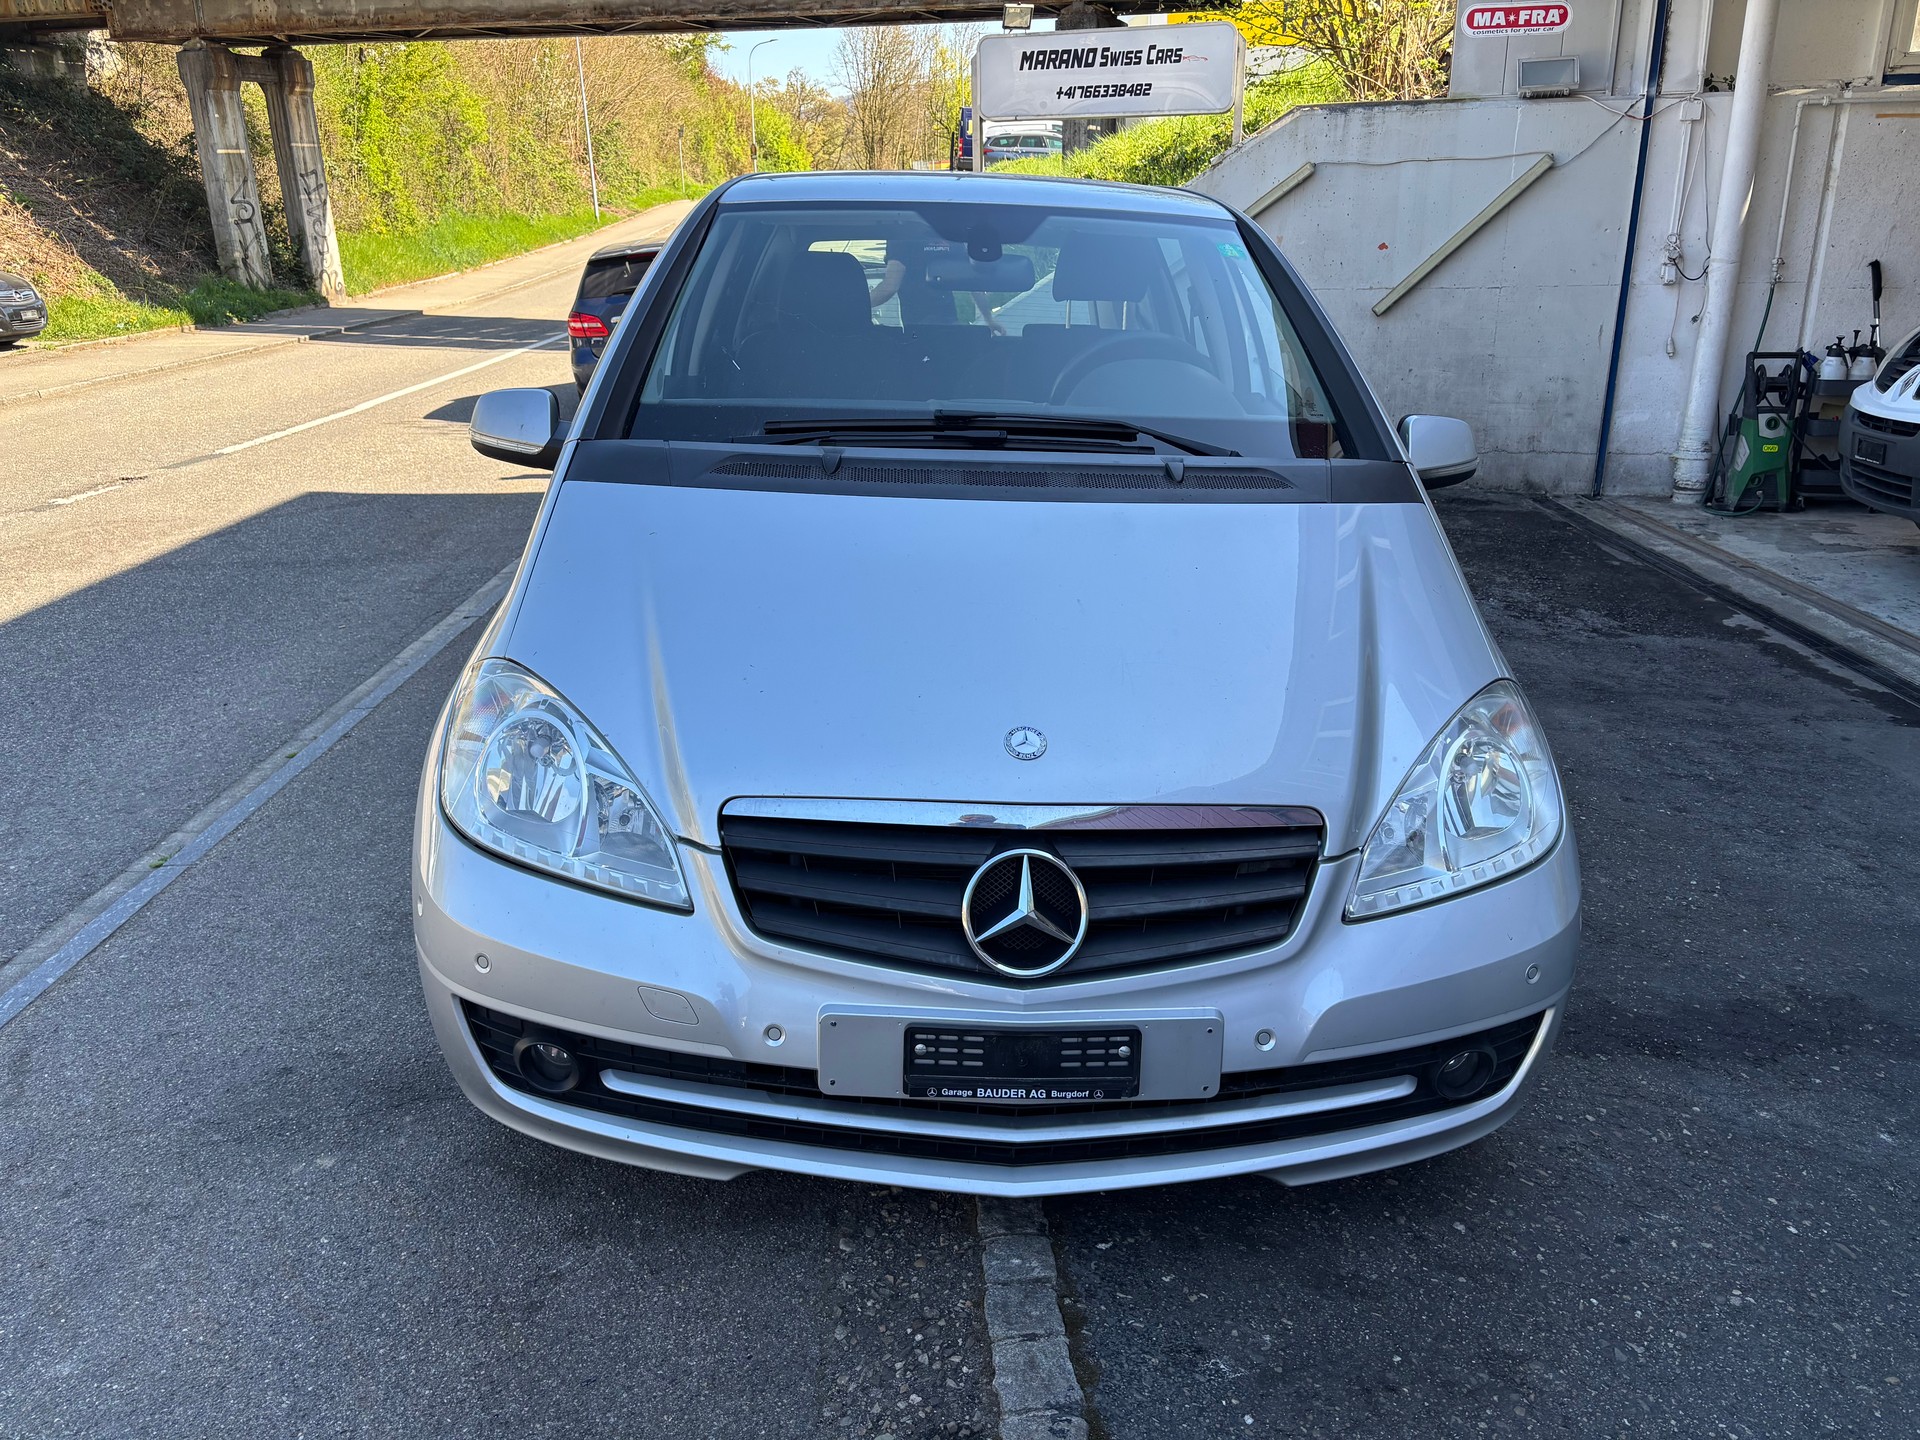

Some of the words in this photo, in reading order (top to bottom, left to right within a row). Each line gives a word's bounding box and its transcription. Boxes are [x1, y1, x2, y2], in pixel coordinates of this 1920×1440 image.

[1473, 11, 1506, 27] MA
[1472, 28, 1508, 36] cosmetics
[1019, 47, 1098, 71] MARANO
[1056, 82, 1152, 100] +41766338482
[941, 1088, 973, 1097] Garage
[976, 1088, 1026, 1098] BAUDER
[1029, 1089, 1047, 1099] AG
[1051, 1090, 1090, 1099] Burgdorf
